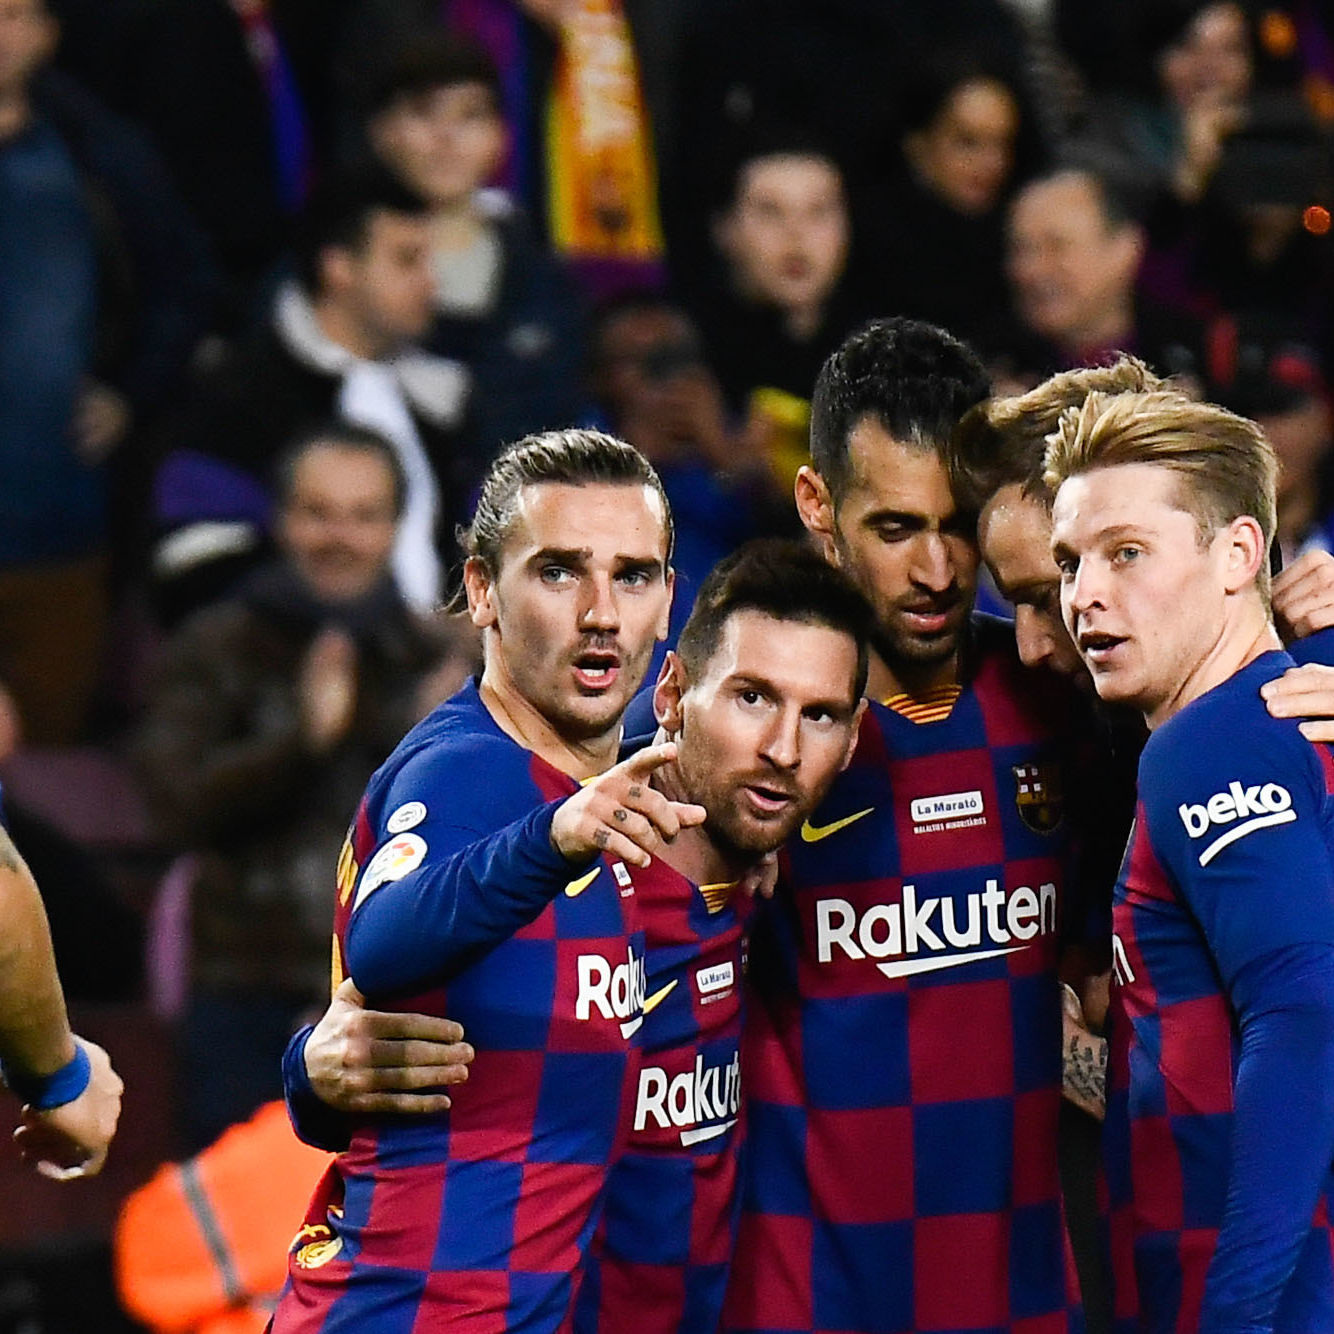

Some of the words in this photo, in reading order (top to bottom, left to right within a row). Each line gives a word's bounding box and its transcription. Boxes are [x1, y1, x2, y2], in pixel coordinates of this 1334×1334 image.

[917, 805, 931, 815] La
[1178, 780, 1292, 838] beko
[816, 879, 1057, 963] Rakuten
[575, 945, 646, 1020] Raku
[633, 1050, 741, 1131] Rakut
